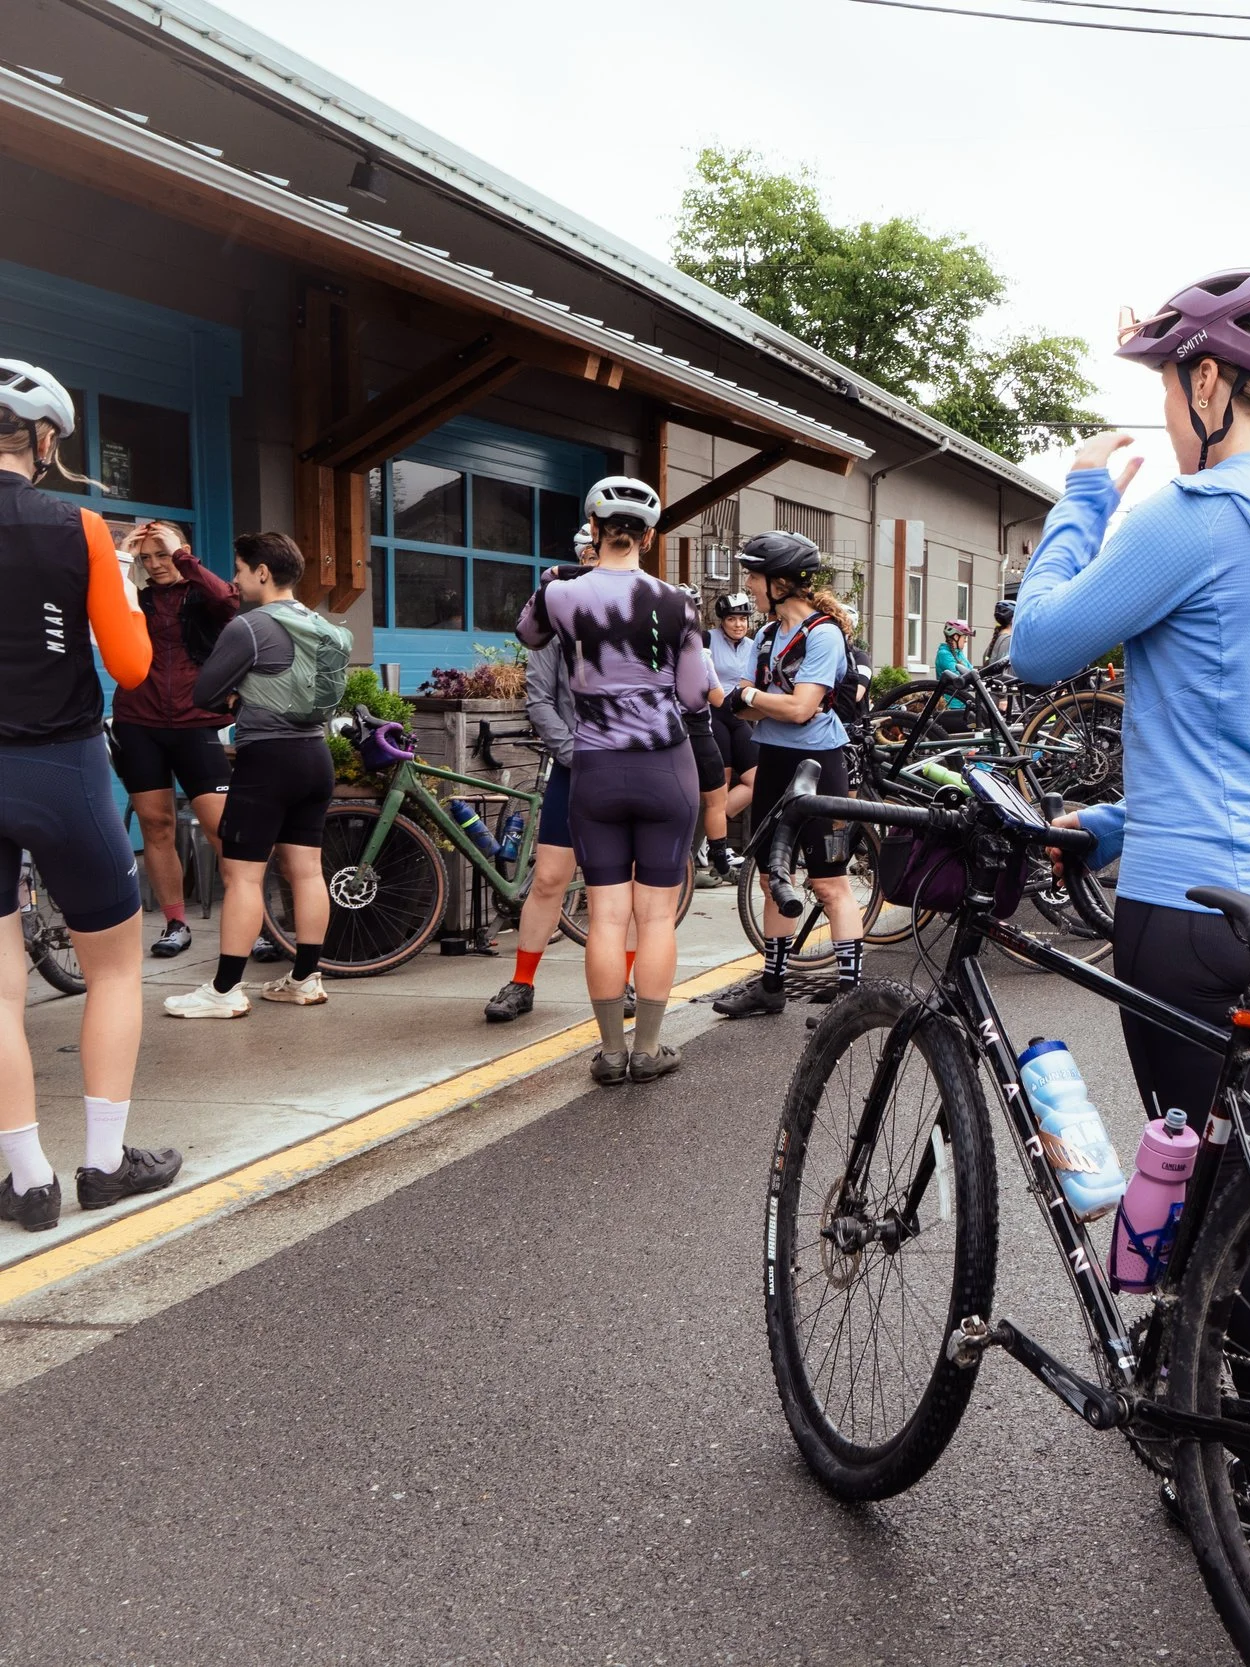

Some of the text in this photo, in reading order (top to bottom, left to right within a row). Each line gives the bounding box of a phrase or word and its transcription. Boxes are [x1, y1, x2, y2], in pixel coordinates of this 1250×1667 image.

[1176, 329, 1208, 358] SMITH
[43, 602, 66, 653] MAAP
[979, 1017, 1090, 1276] MARIN
[767, 1195, 779, 1260] RAMBLER
[1164, 1486, 1176, 1500] SPD
